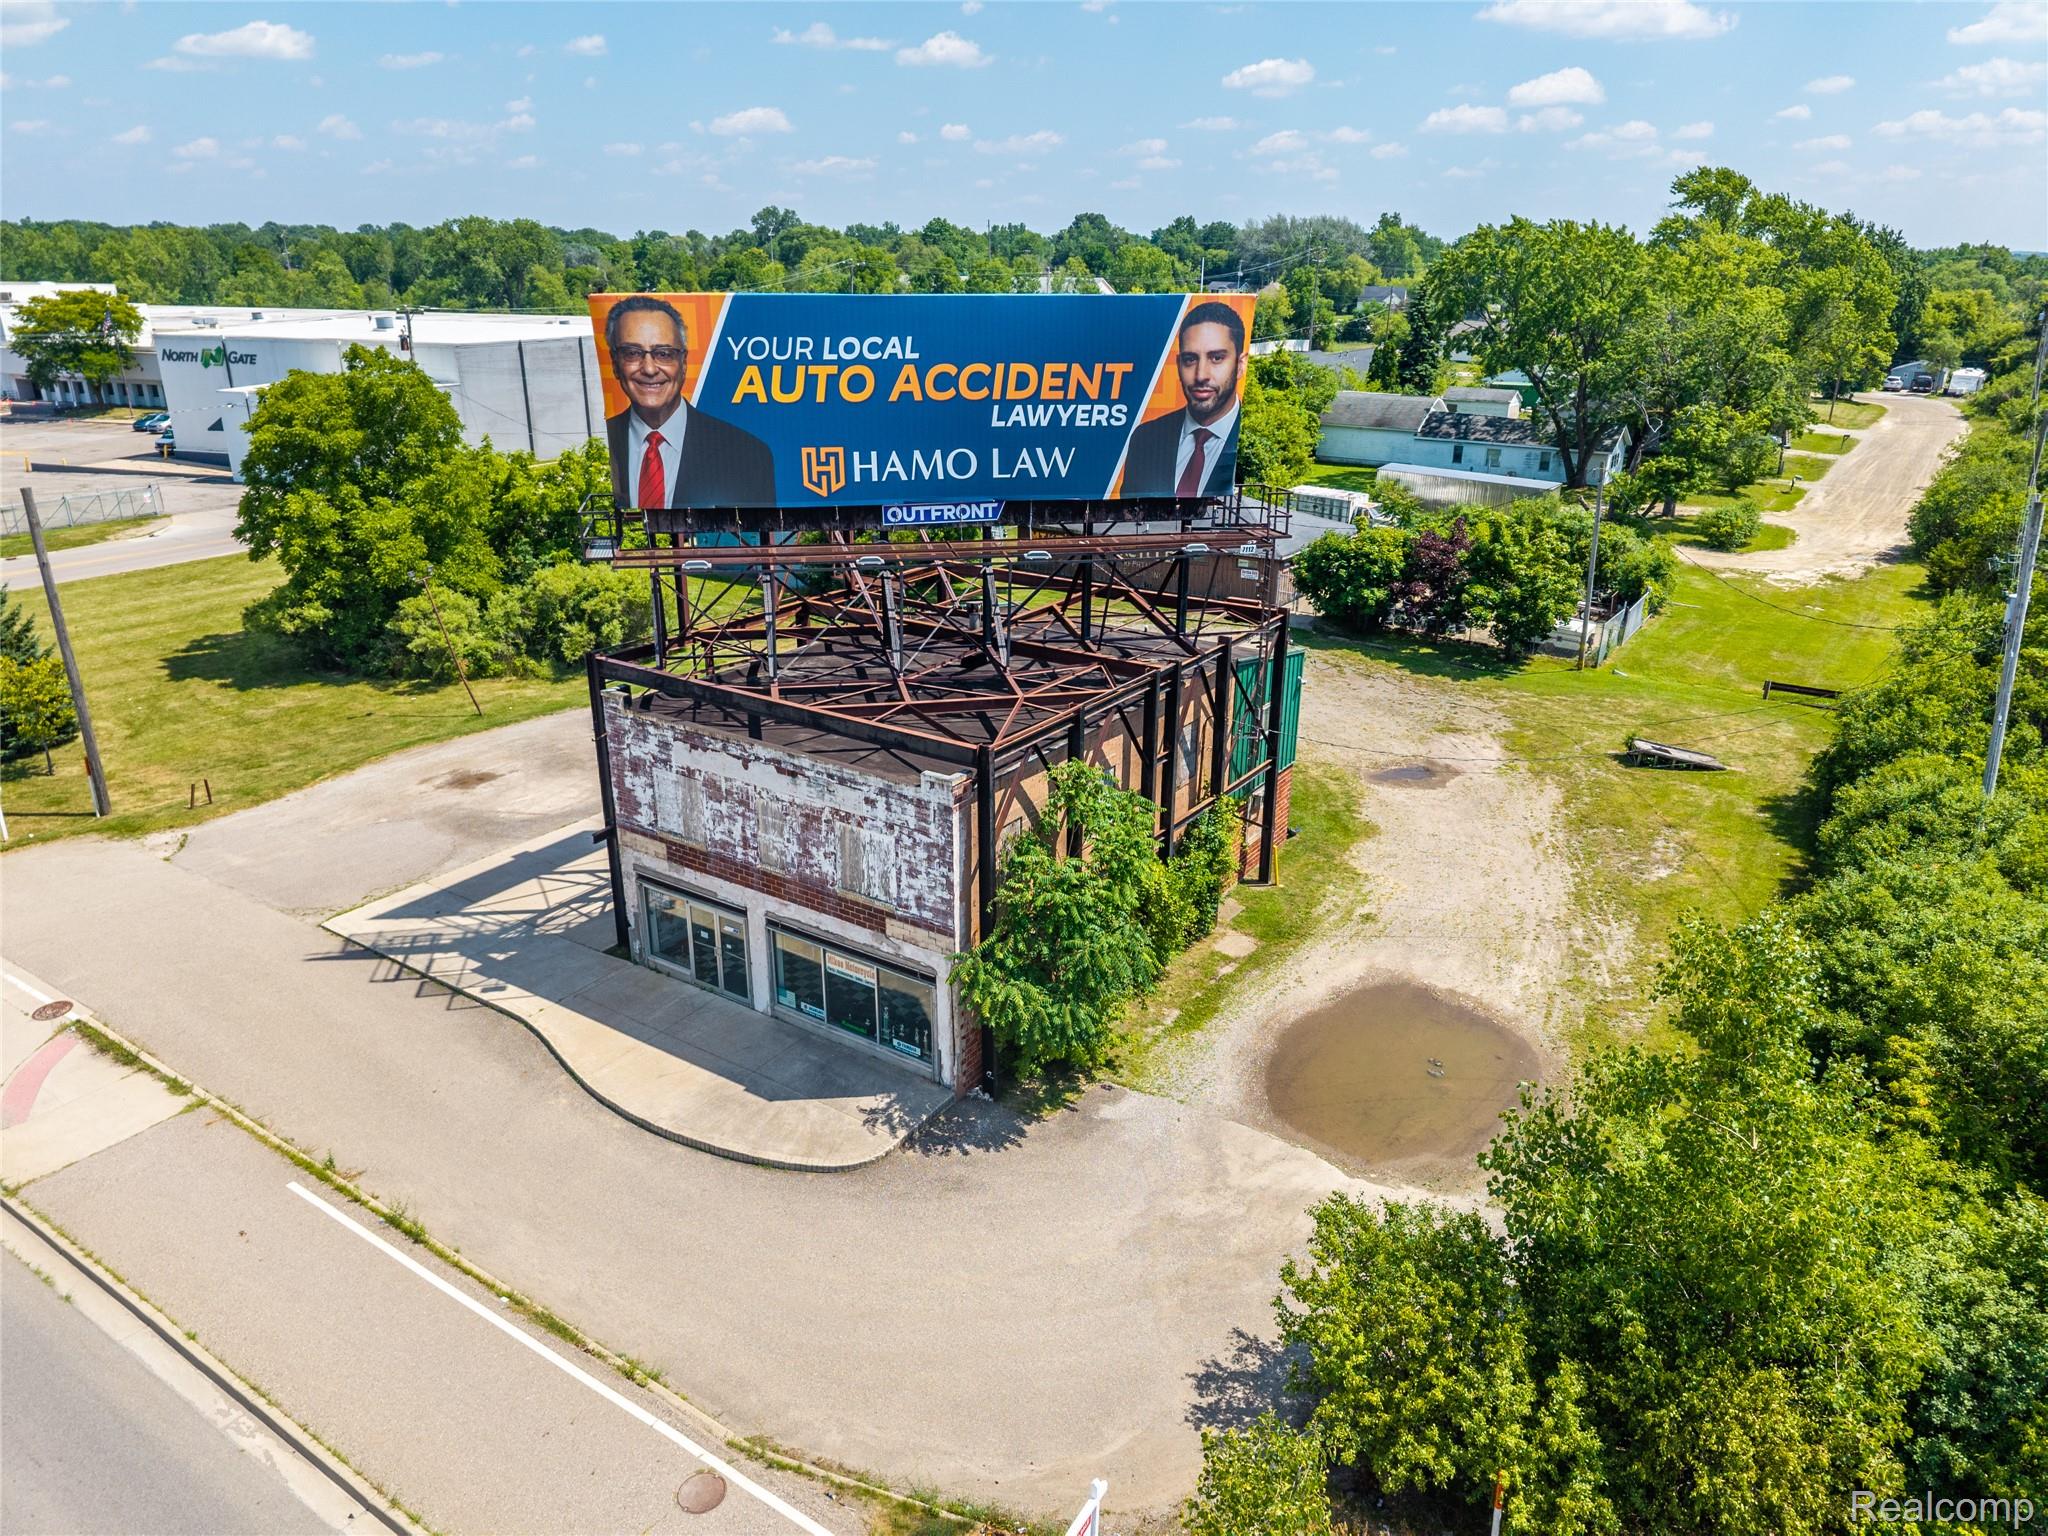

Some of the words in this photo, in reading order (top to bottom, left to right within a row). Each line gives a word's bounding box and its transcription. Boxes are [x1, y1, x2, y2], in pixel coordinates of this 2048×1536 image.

[161, 348, 199, 362] NORTH
[228, 351, 257, 365] GATE
[727, 336, 814, 361] YOUR
[822, 336, 920, 361] LOCAL
[731, 364, 876, 404] AUTO
[887, 362, 1134, 402] ACCIDENT
[991, 403, 1128, 428] LAWYERS
[852, 448, 978, 483] HAMO
[992, 446, 1076, 479] LAW
[886, 502, 999, 523] OUTFRONT
